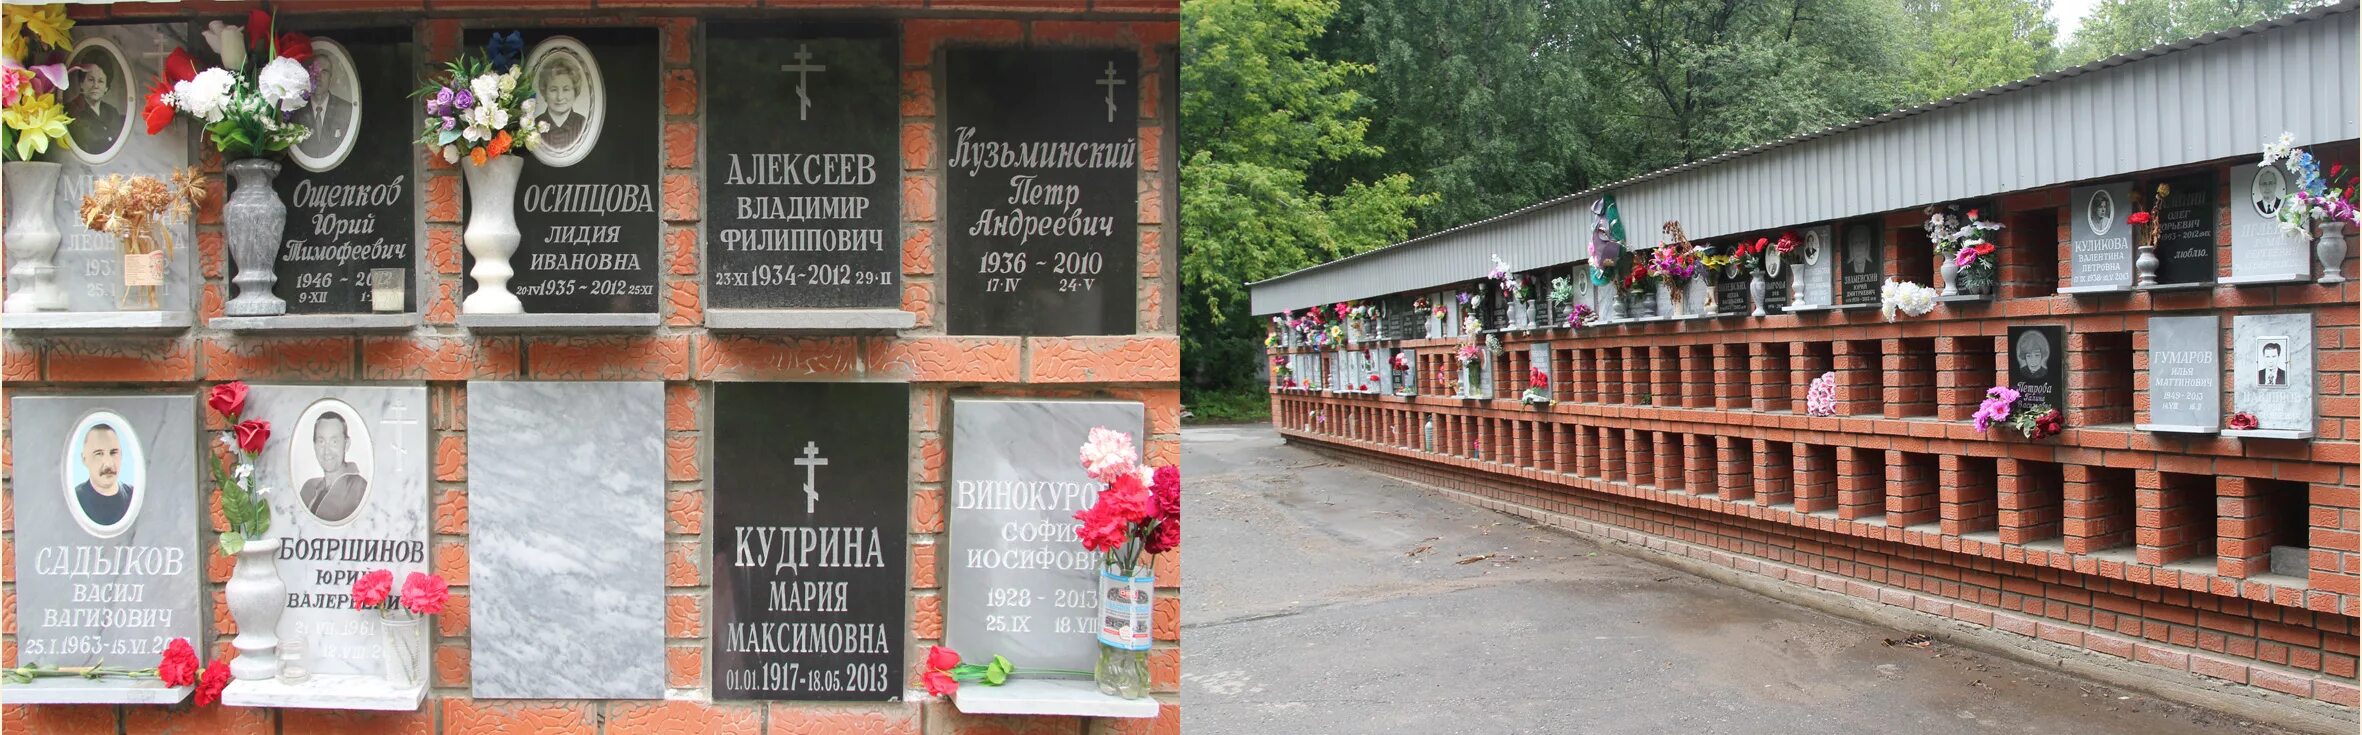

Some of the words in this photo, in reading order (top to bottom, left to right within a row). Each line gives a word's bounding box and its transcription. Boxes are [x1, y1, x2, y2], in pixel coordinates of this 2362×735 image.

[949, 126, 1136, 176] Кузьминский
[724, 154, 876, 185] АЛЕКСЕЕВ
[293, 175, 404, 213] Ощепков
[523, 184, 655, 216] ОСИПЦОВА
[1008, 174, 1079, 213] Петр
[737, 197, 869, 222] ВЛАДИМИР
[311, 213, 375, 242] Юрий
[544, 226, 621, 246] ЛИДИЯ
[969, 208, 1113, 246] Андреевич
[720, 229, 883, 251] ФИЛИППОВИЧ
[2075, 237, 2128, 252] КУЛИКОВА
[282, 238, 406, 266] Тимофеевич
[530, 253, 641, 270] ИВАНОВНА
[979, 251, 1026, 274] 1936
[1053, 251, 1103, 275] 2010
[2078, 252, 2124, 263] ВАЛЕНТИНА
[2082, 262, 2120, 272] ПЕТРОВНА
[296, 273, 332, 288] 1946
[590, 280, 626, 295] 2012
[2154, 351, 2213, 364] ГУМАРОВ
[2155, 378, 2213, 387] МАТТИНОВИЧ
[2171, 368, 2194, 376] ИЛЬЯ
[2017, 381, 2053, 395] Петрова
[35, 545, 184, 578] САДЫКОВ
[279, 537, 424, 563] БОЯРШИНОВ
[734, 526, 885, 576] КУДРИНА
[72, 583, 145, 602] ВАСИЛ
[768, 581, 848, 611] МАРИЯ
[986, 588, 1031, 607] 1928
[1054, 589, 1098, 608] 2013
[42, 608, 173, 628] ВАГИЗОВИЧ
[726, 622, 889, 653] МАКСИМОВНА
